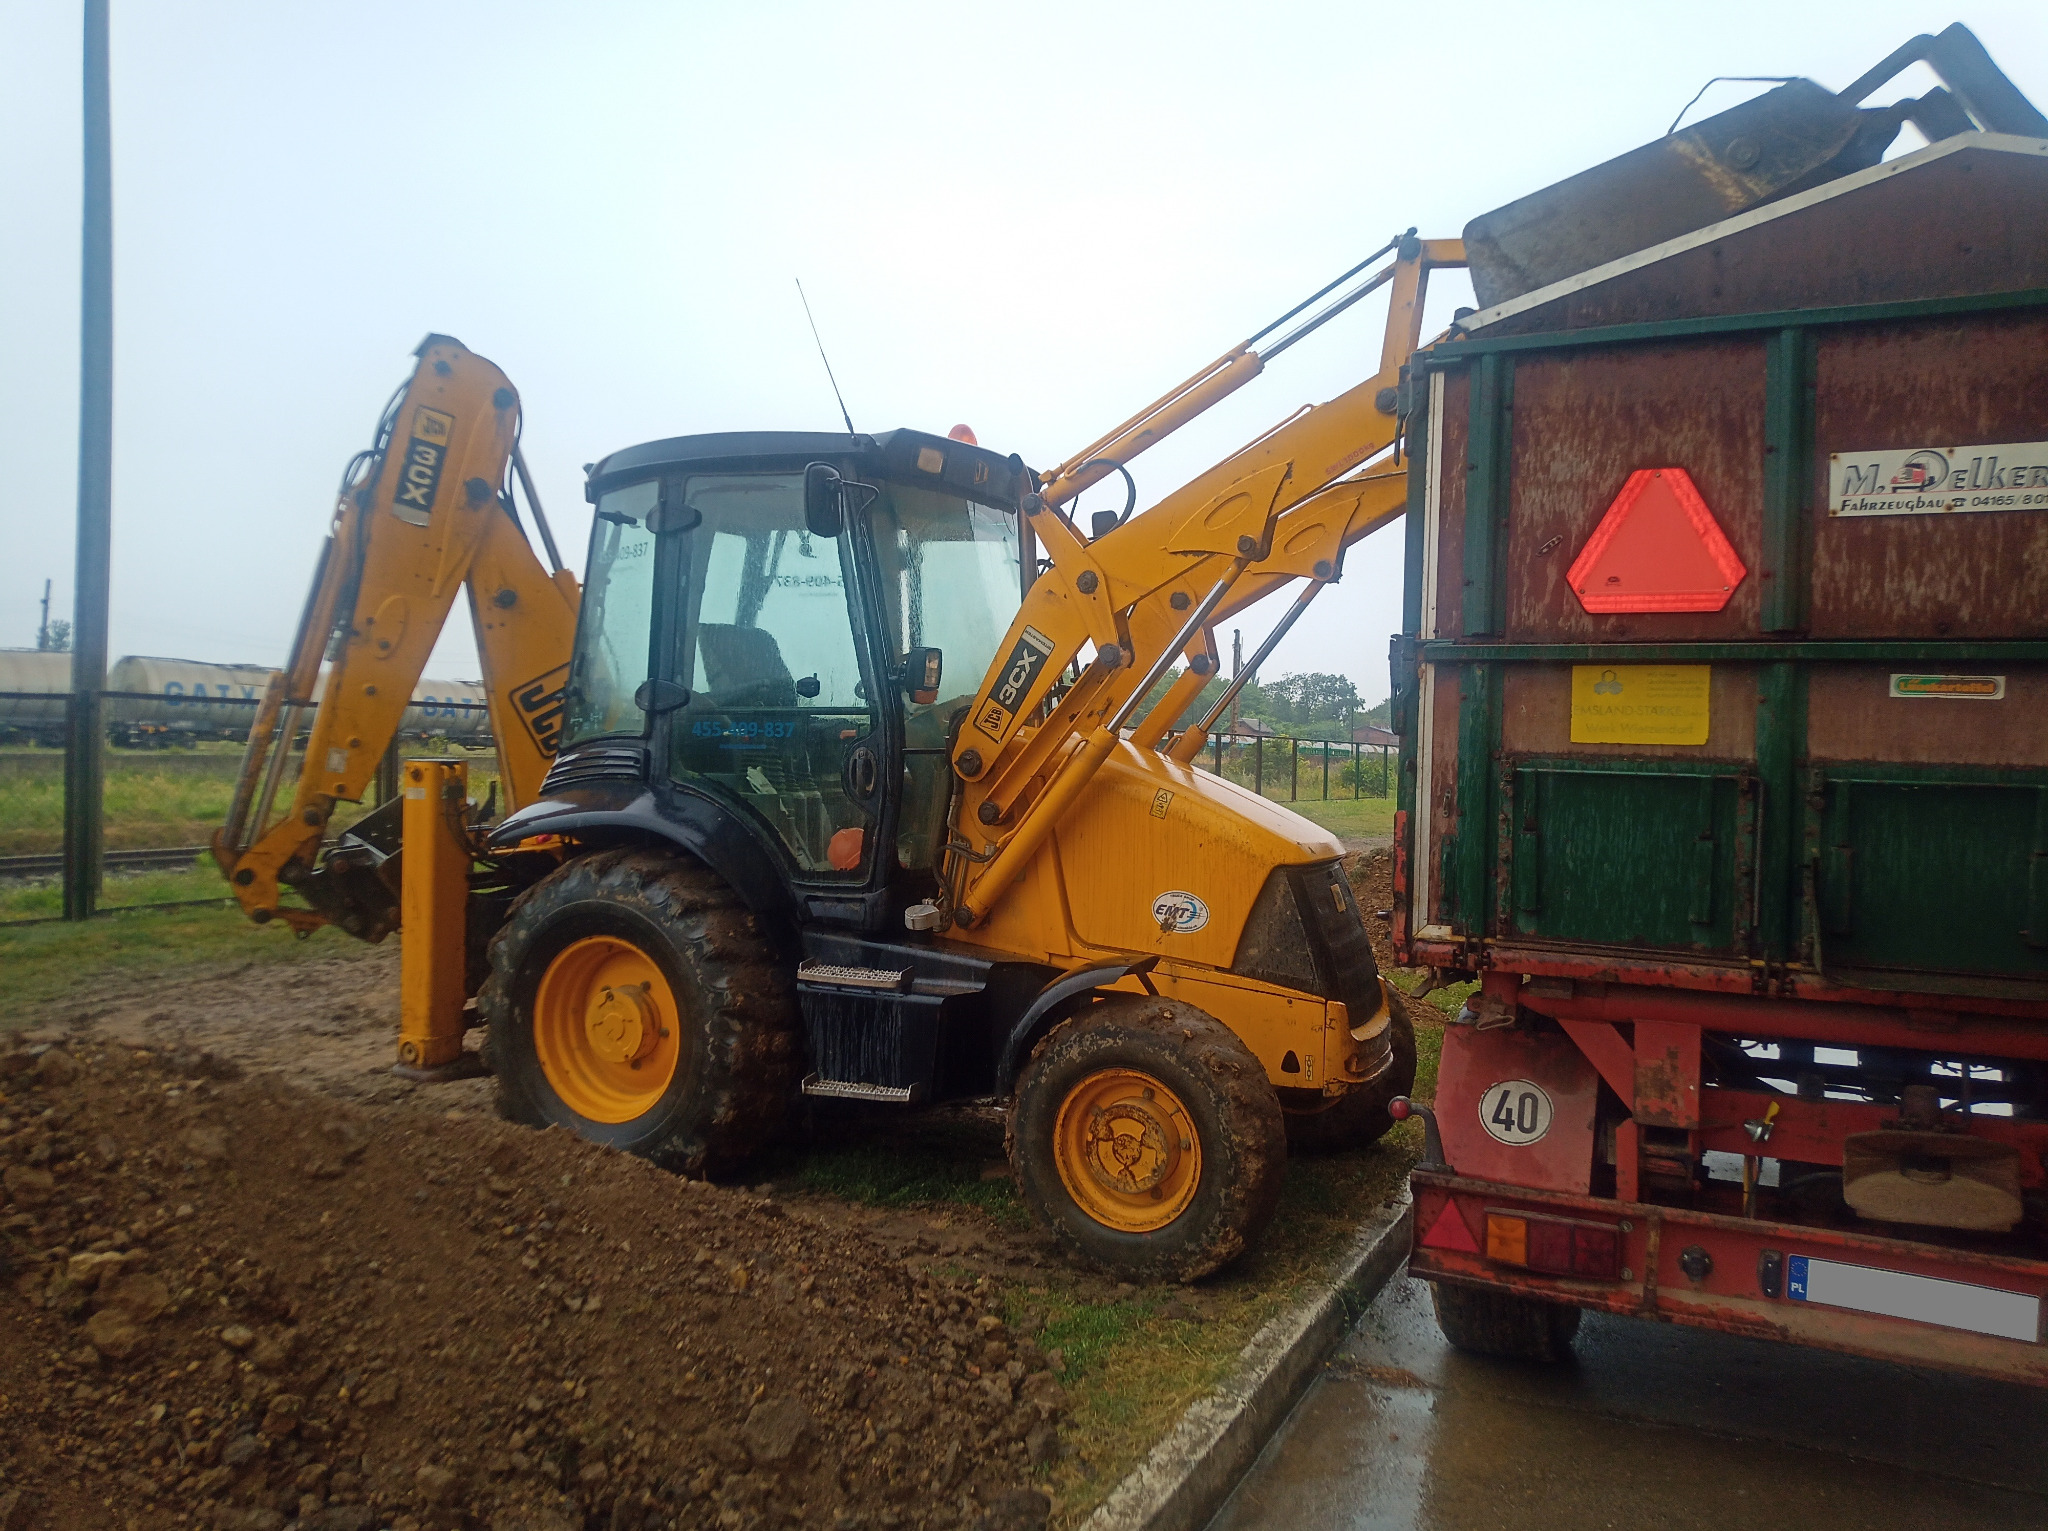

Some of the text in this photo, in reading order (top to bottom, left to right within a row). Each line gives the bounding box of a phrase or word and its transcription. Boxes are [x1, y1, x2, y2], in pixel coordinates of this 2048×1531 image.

[401, 445, 438, 506] 3CX
[1841, 464, 1885, 495] M.
[999, 648, 1037, 705] 3CX
[423, 696, 488, 719] GAT
[984, 708, 1003, 729] JCB
[1156, 904, 1190, 919] EMT
[1492, 1090, 1538, 1134] 40
[1791, 1282, 1804, 1293] PL
